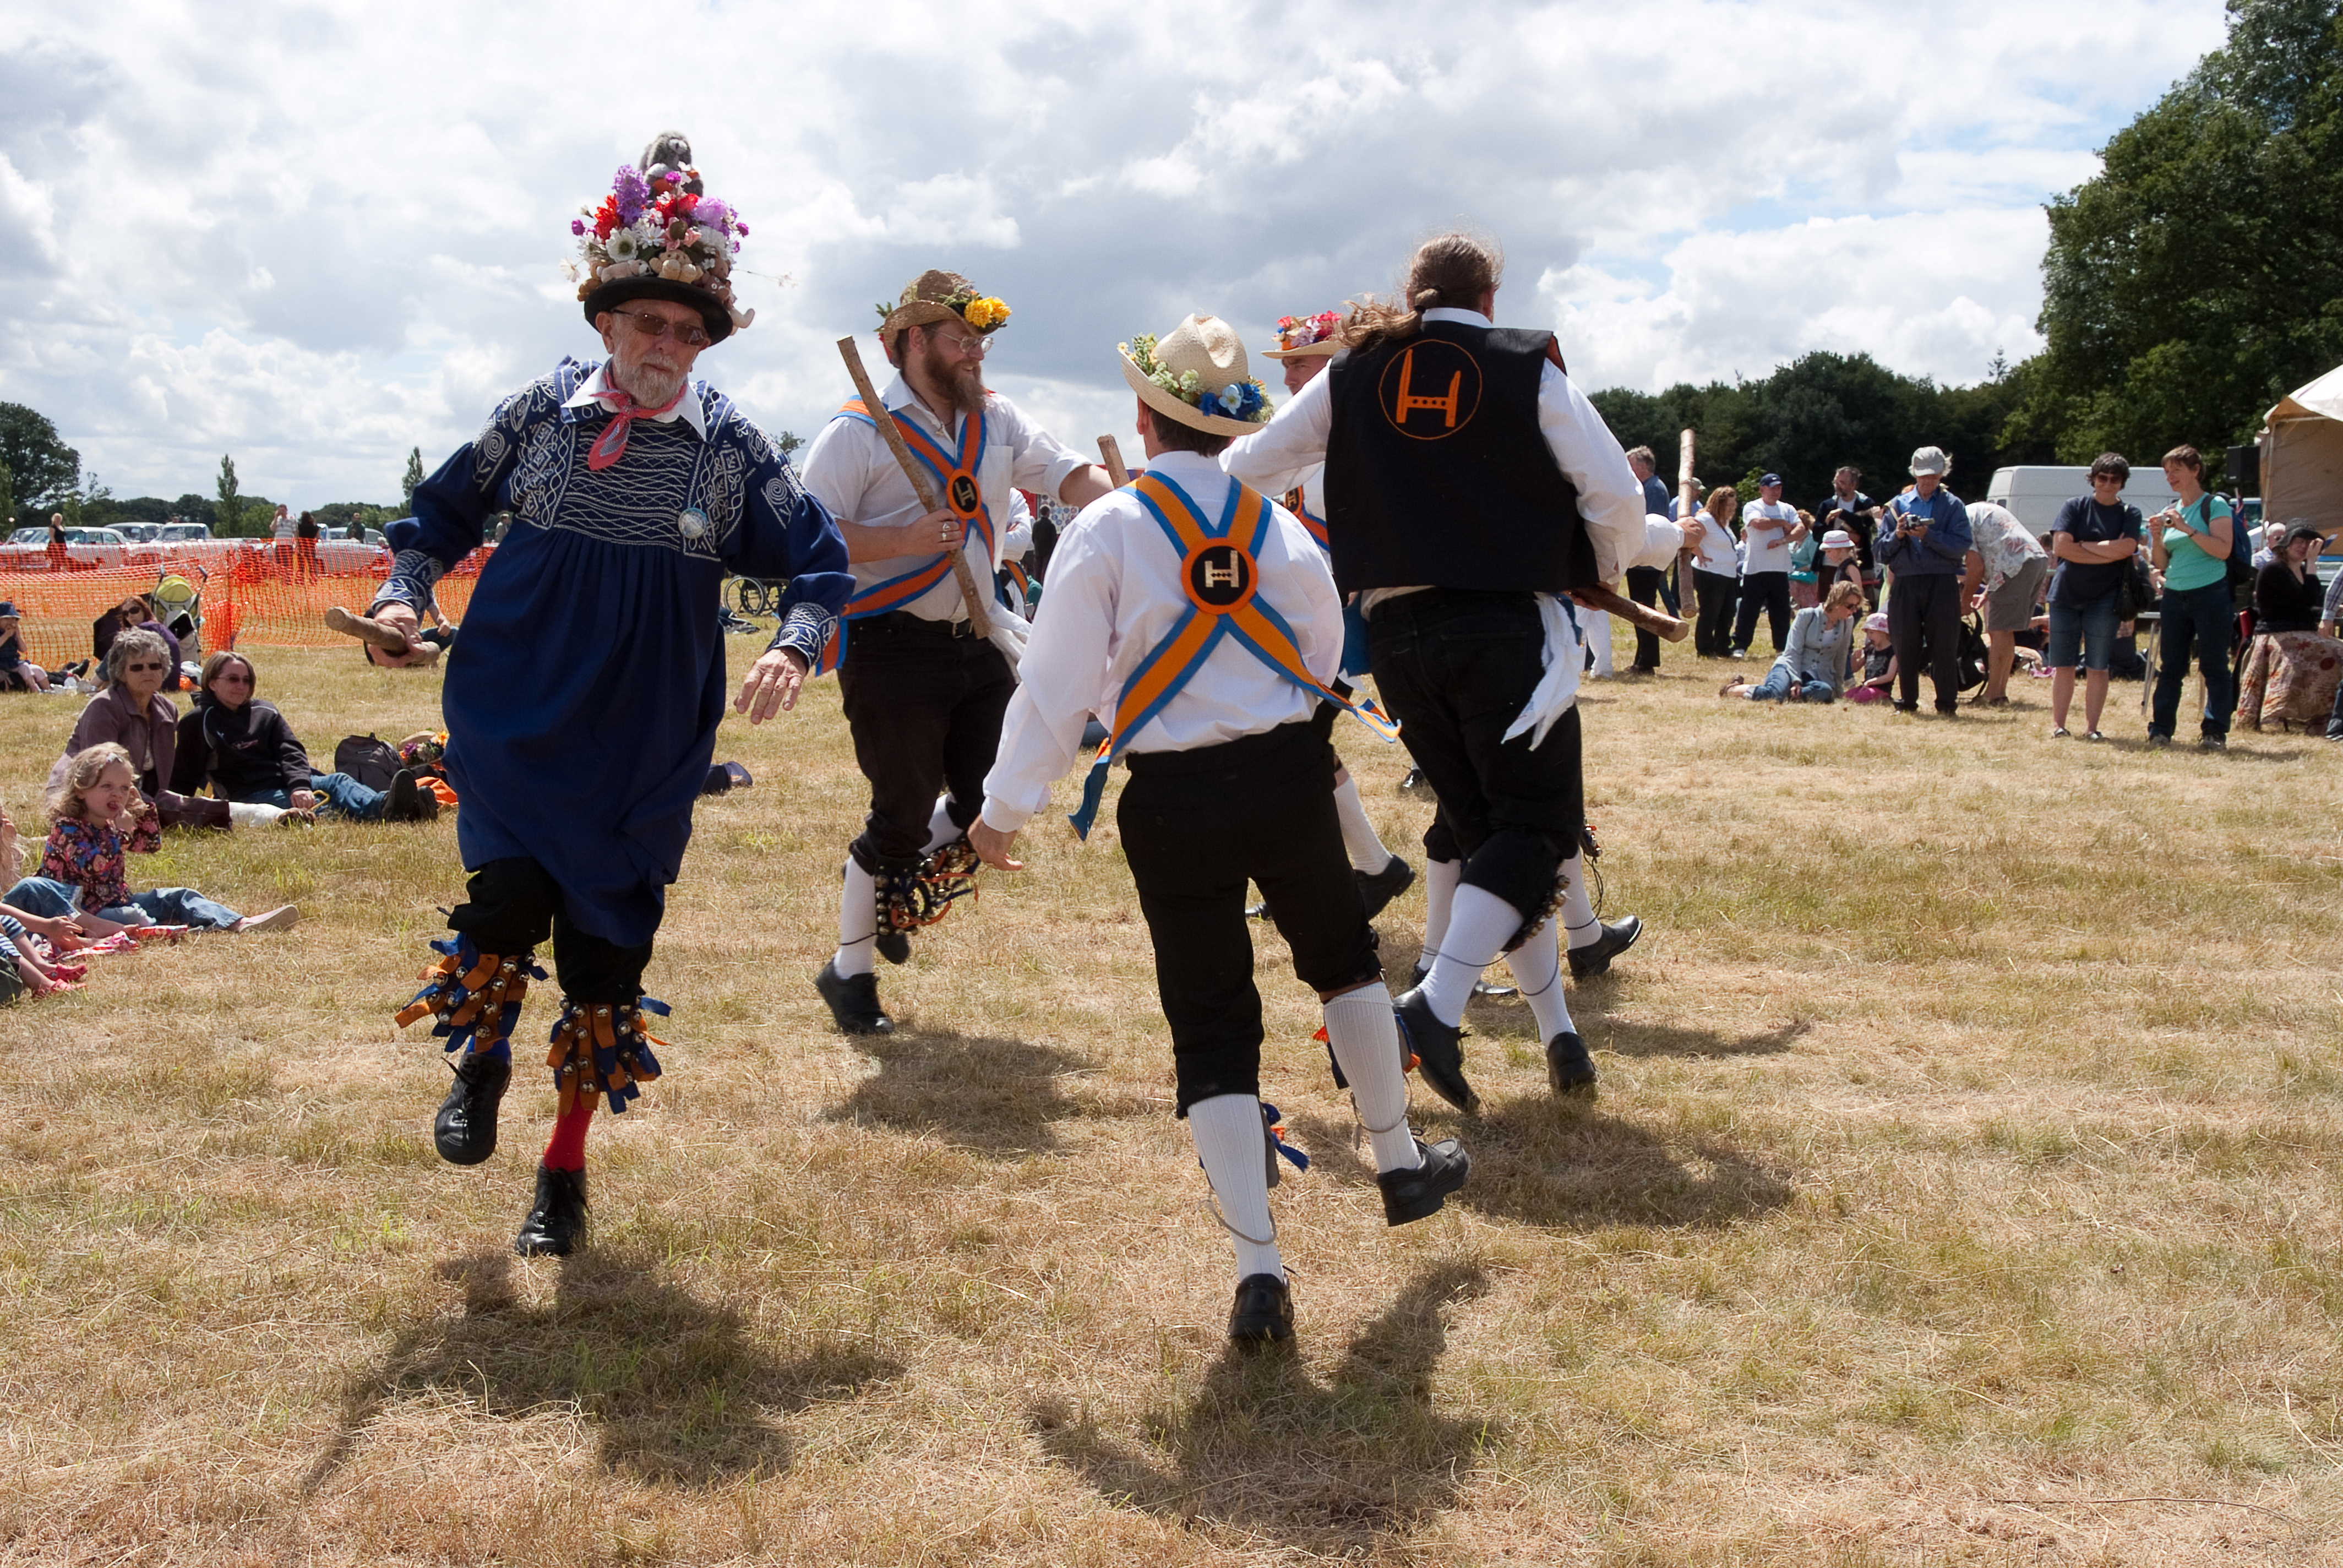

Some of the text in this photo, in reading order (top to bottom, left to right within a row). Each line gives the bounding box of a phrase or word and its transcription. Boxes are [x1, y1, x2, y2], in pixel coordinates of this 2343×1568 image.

[1396, 349, 1461, 427] H
[955, 482, 976, 507] H
[1205, 549, 1239, 588] H
